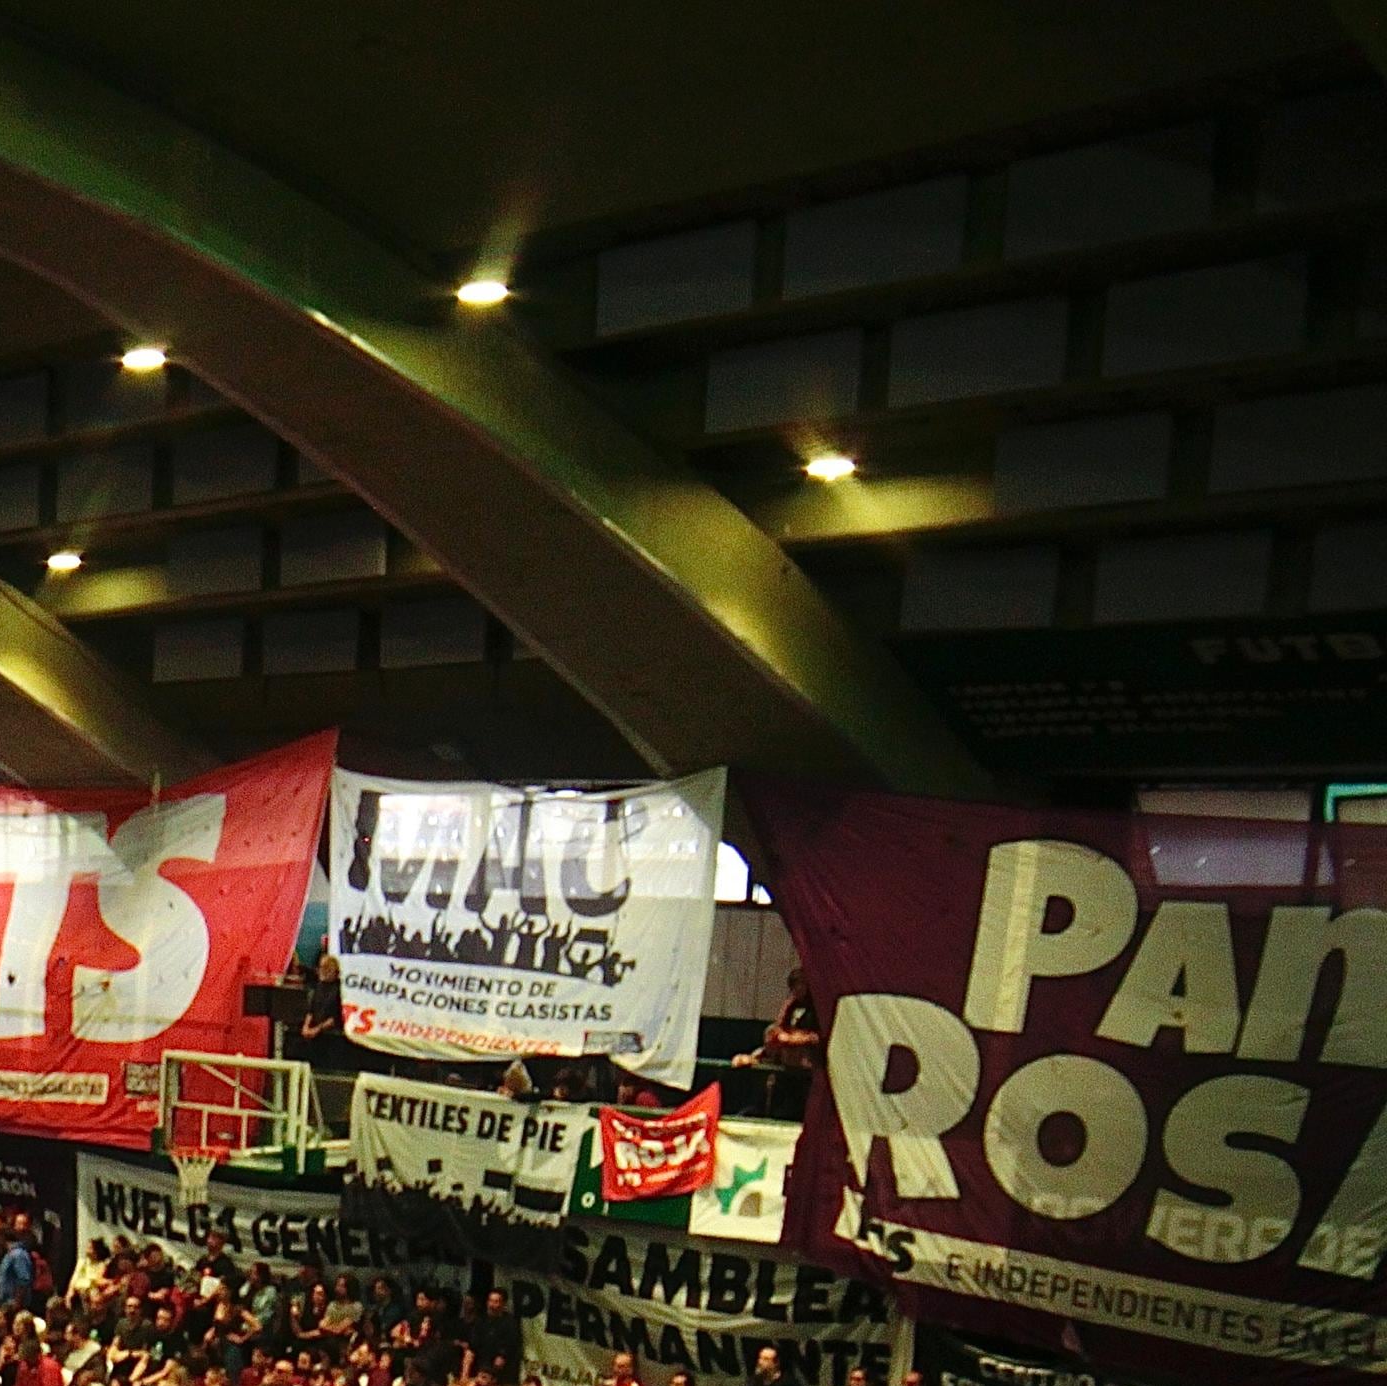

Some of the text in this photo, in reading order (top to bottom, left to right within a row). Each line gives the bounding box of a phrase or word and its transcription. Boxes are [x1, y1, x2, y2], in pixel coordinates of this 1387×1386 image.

[346, 788, 633, 919] MAC
[343, 972, 614, 1022] GRUPACIONES CLASISTAS
[388, 962, 558, 998] MOVIMIENTO DE
[363, 1088, 471, 1137] TEXTILES
[477, 1111, 515, 1144] DE
[520, 1115, 568, 1155] PIE
[95, 1178, 243, 1254] HUELGA
[562, 1223, 891, 1324] SAMBLEA
[972, 1259, 1264, 1346] INDEPENDIENTES
